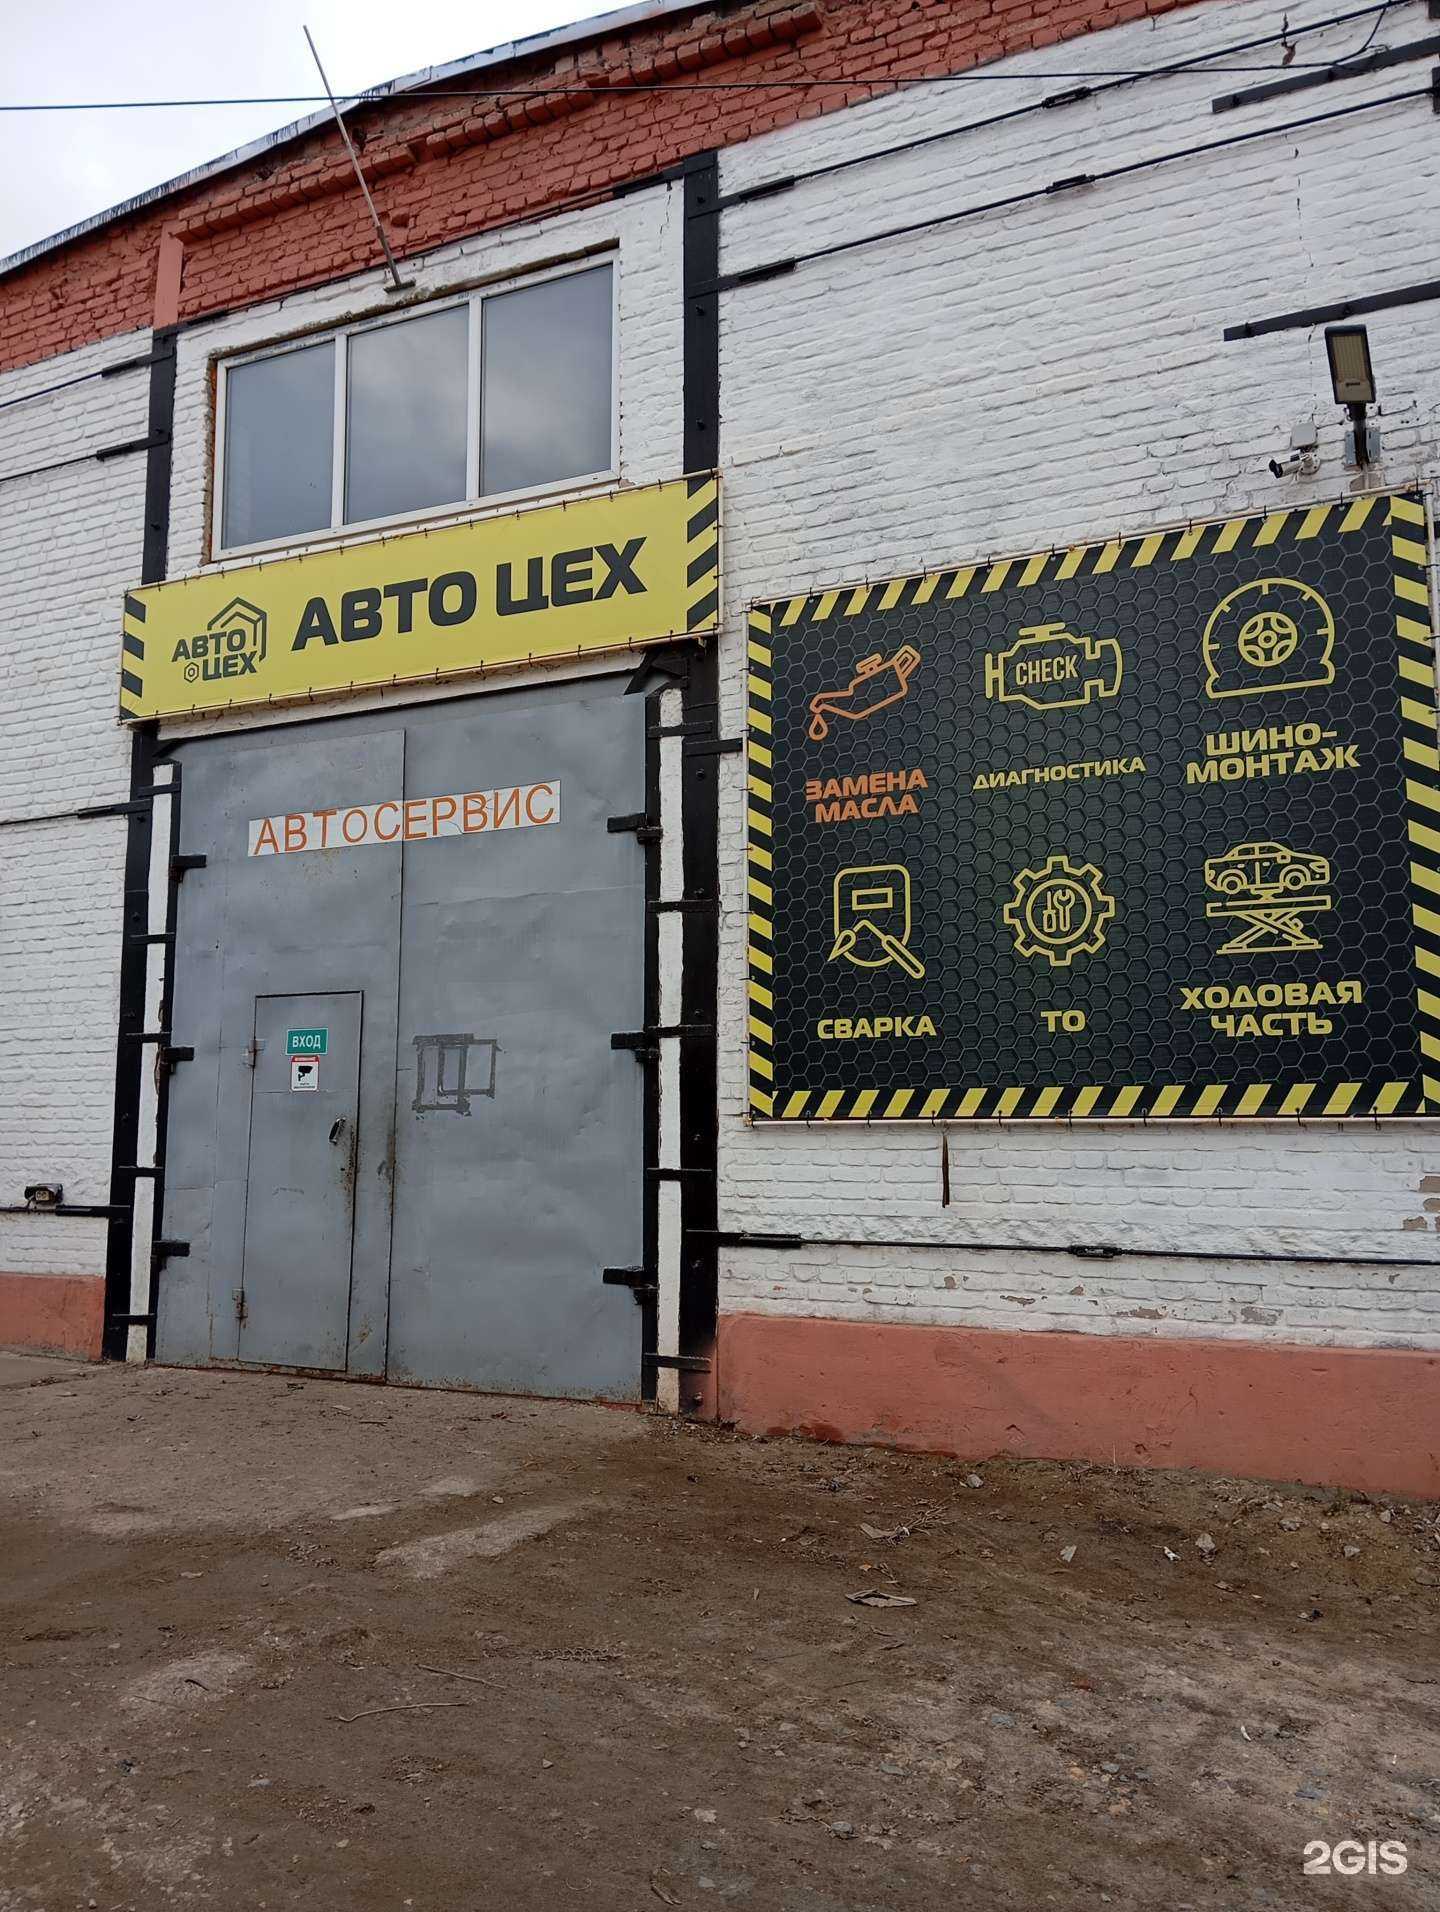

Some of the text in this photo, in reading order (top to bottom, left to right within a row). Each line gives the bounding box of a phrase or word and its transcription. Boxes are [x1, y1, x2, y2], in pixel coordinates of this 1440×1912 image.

[292, 536, 648, 651] АВТО ЦЕХ
[171, 628, 246, 662] АВТО
[202, 650, 257, 681] ЦЕХ
[1015, 655, 1078, 686] CHECK
[1206, 722, 1337, 757] ШИНО-
[973, 756, 1147, 790] ДИАГНОСТИКА
[1186, 744, 1361, 784] МОНТАЖ
[805, 768, 929, 801] ЗАМЕНА
[253, 784, 555, 856] АВТОСЕРВИС
[815, 794, 919, 824] МАСЛА
[1179, 980, 1362, 1010] ХОДОВАЯ
[817, 1015, 937, 1040] СВАРКА
[1040, 1010, 1086, 1033] ТО
[1210, 1011, 1333, 1037] ЧАСТЬ
[292, 1035, 321, 1049] ВХОД
